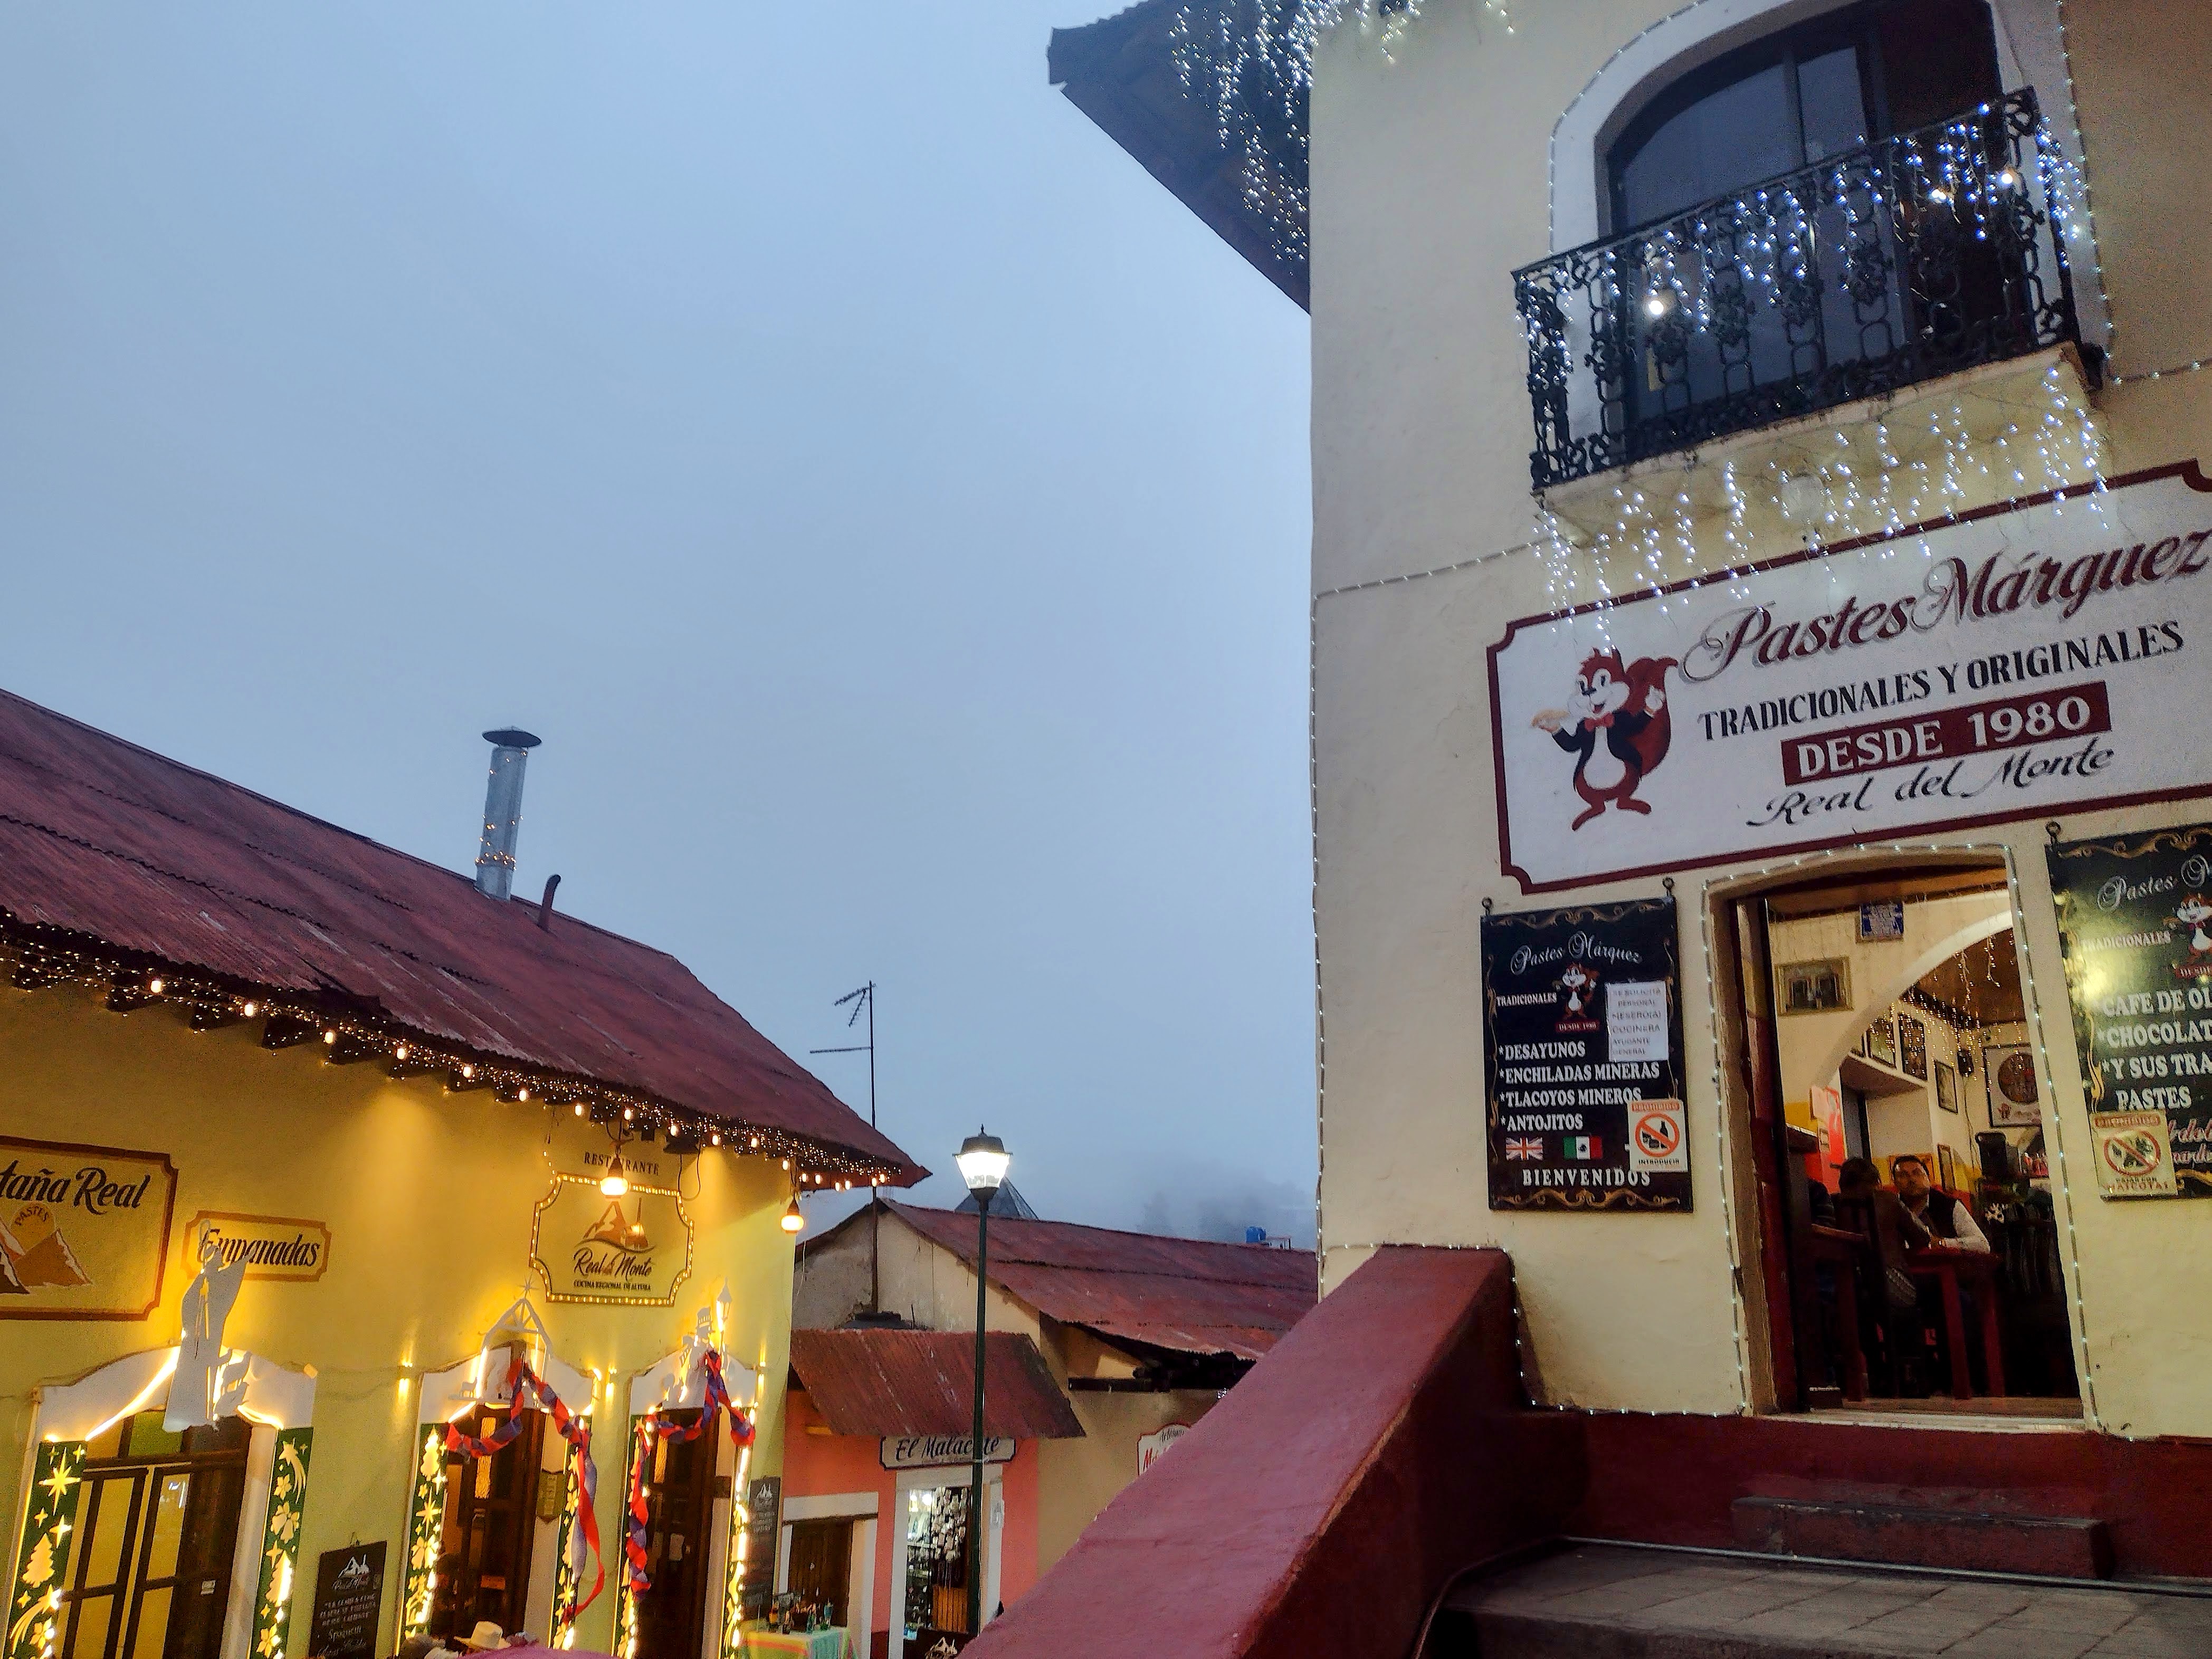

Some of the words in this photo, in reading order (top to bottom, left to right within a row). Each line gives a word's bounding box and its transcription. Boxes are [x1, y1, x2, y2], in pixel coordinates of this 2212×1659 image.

[1681, 596, 1916, 681] Pastes
[1697, 669, 1929, 740] TRADICIONALES
[1937, 665, 1960, 694] Y
[1967, 620, 2185, 689] ORIGINALES
[1797, 720, 1943, 779] DESDE
[1967, 697, 2091, 746] 1980
[1746, 777, 1874, 826] Real
[1894, 761, 1961, 801] del
[1960, 738, 2115, 798] Monte
[2097, 875, 2174, 913] Pastes
[1510, 945, 1563, 975] Pastes
[1496, 992, 1557, 1007] TRADICIONALES
[2157, 989, 2186, 1013] DE
[1595, 1061, 1660, 1081] MINERAS
[2129, 1055, 2169, 1079] SUS
[1578, 1087, 1642, 1105] MINEROS
[2115, 1084, 2192, 1110] PASTES
[584, 1151, 660, 1176] RESTRANTE
[1522, 1168, 1651, 1187] BIENVENIDOS
[73, 1167, 151, 1216] Real
[574, 1246, 608, 1277] Real
[611, 1251, 654, 1282] Monte
[895, 1438, 919, 1462] El
[921, 1436, 1000, 1460] Malacte
